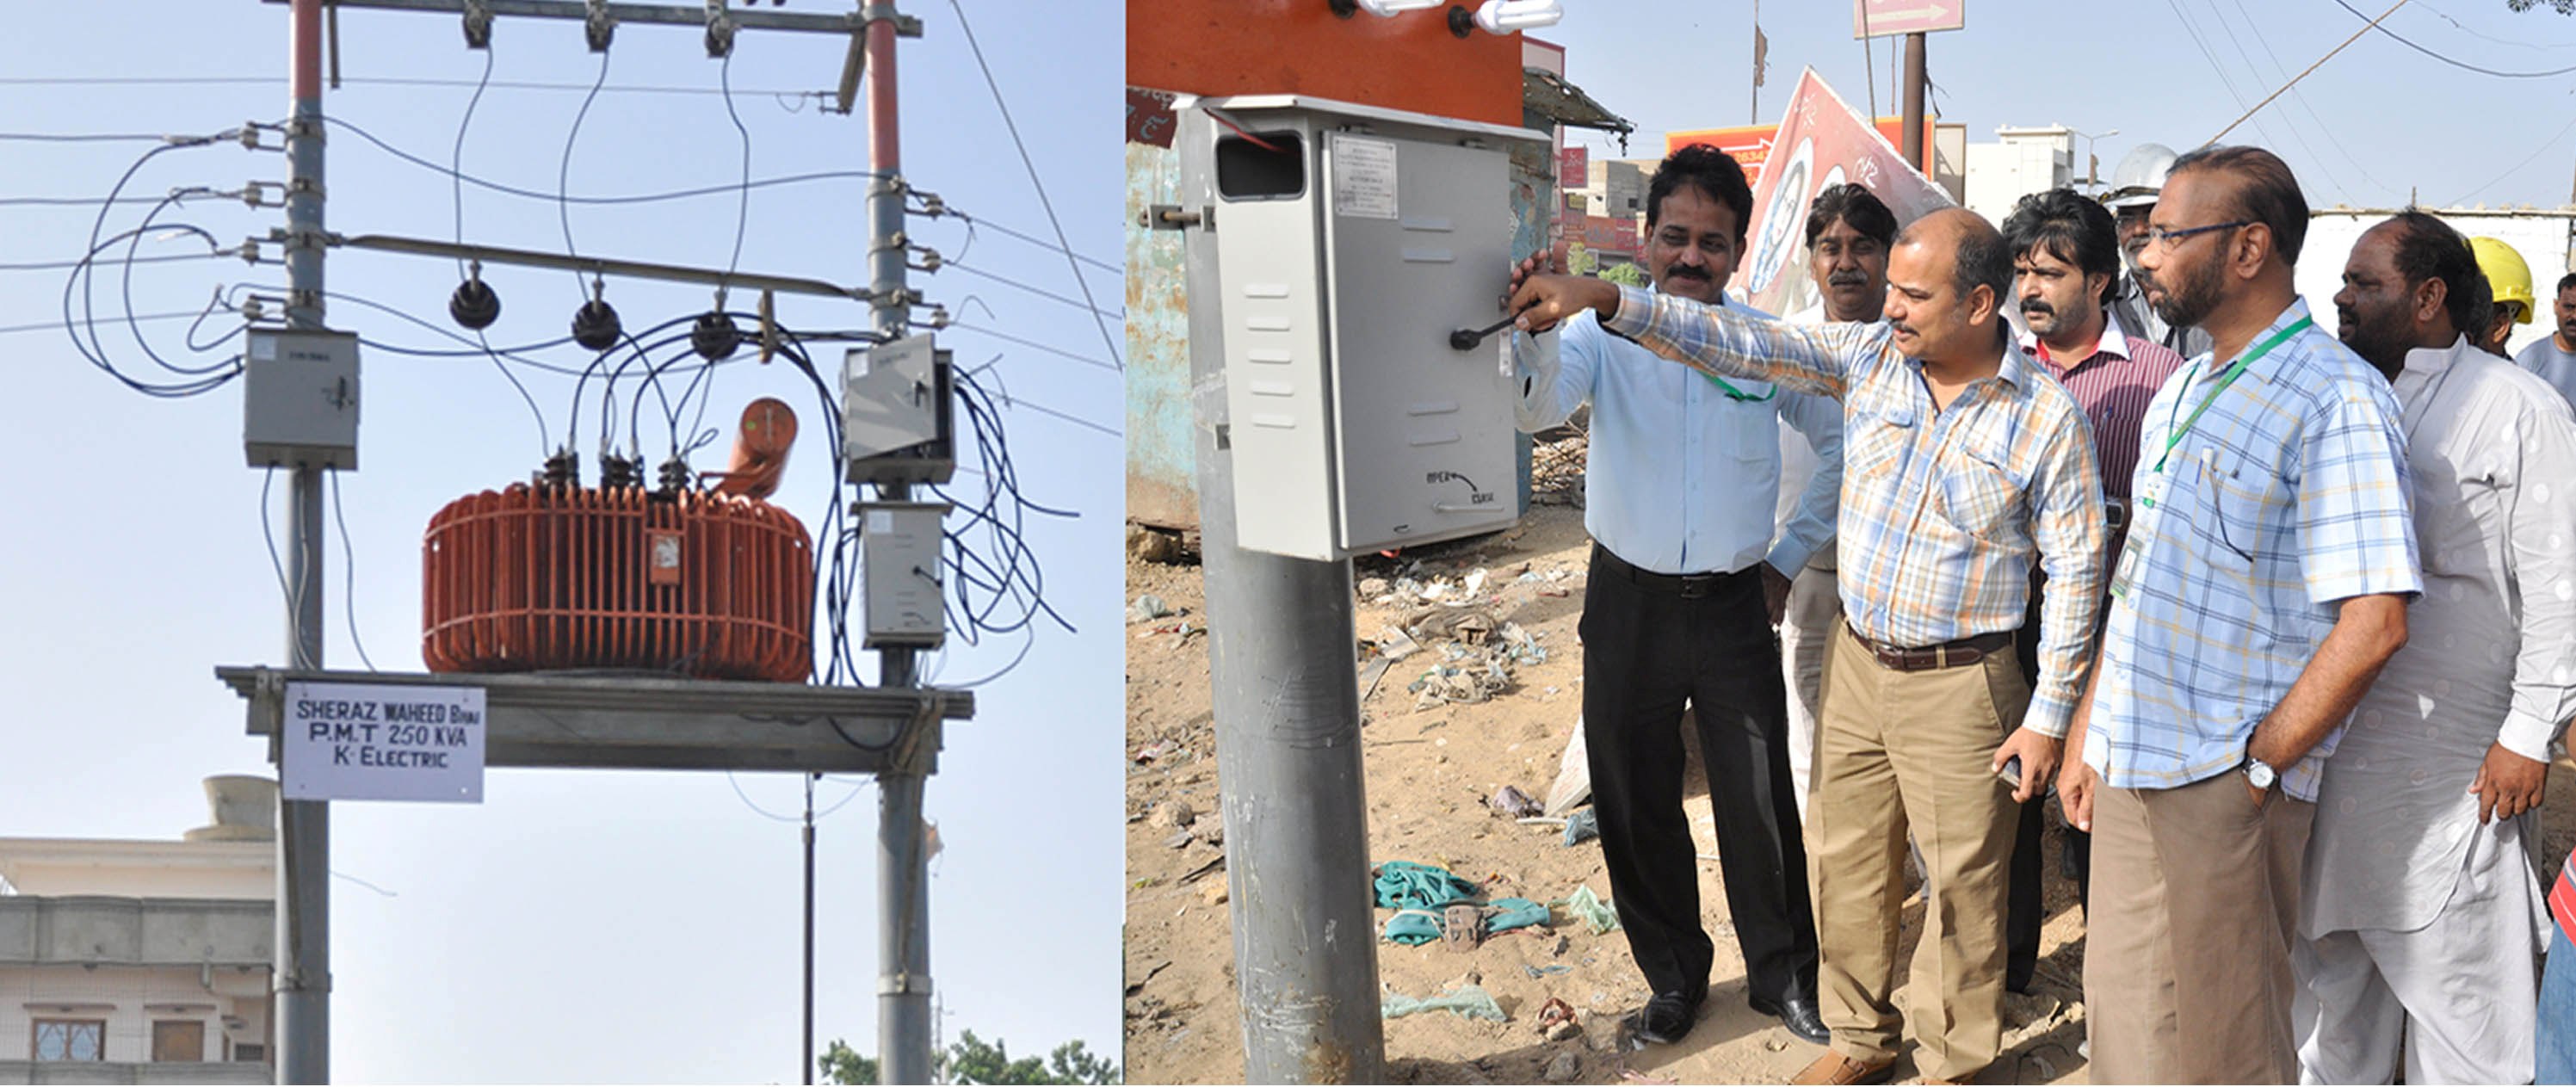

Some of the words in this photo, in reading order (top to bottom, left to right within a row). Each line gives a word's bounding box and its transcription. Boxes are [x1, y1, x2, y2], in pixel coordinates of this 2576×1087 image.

[297, 700, 378, 720] SHERAZ
[385, 702, 446, 724] WAHEED
[309, 722, 379, 743] P.M.T
[388, 725, 429, 746] 250
[435, 726, 468, 746] KVA
